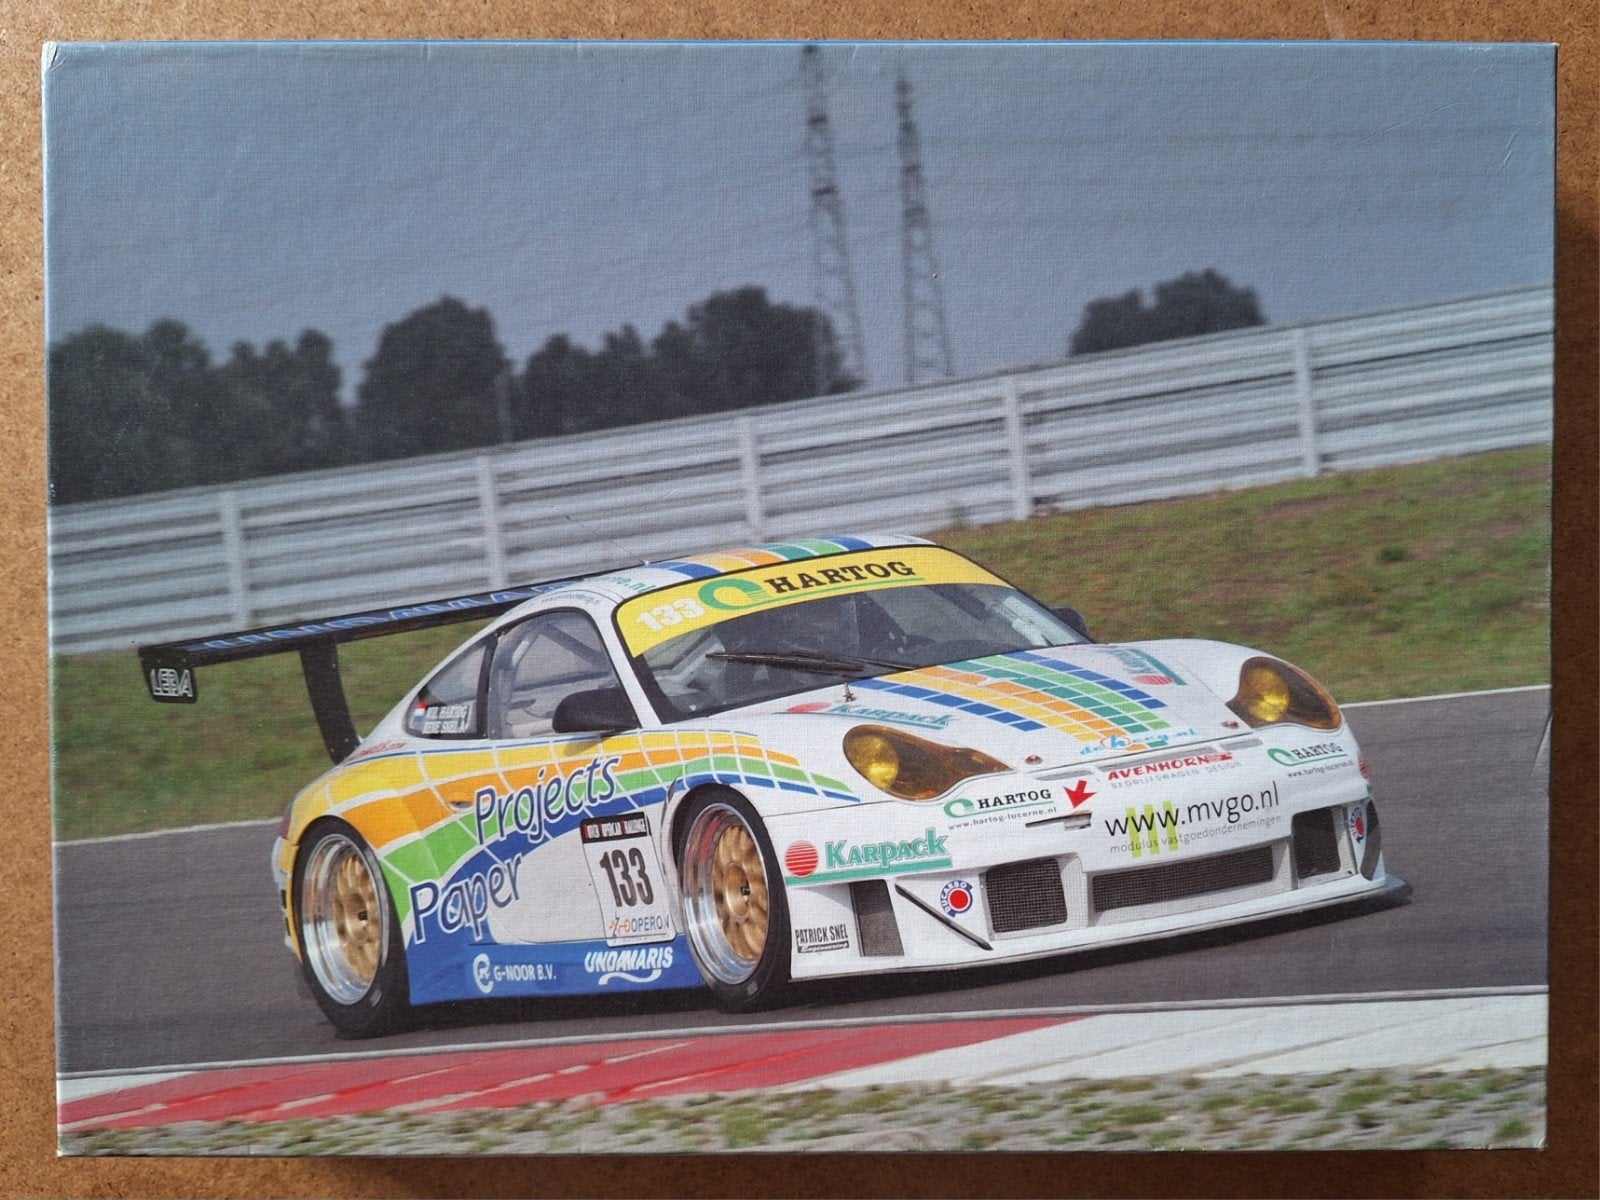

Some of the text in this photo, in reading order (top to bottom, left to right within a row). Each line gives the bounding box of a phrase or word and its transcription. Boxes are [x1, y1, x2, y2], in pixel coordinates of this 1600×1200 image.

[765, 561, 917, 593] HARTOG
[636, 598, 706, 631] 133
[1291, 742, 1343, 760] HARTOG
[1108, 755, 1210, 781] AVENHORN
[476, 755, 622, 845] Projects
[978, 789, 1052, 809] HARTOG
[1105, 780, 1279, 836] www.mvgo.nl
[948, 806, 1057, 830] www.hartog-lucerne.nl
[1110, 815, 1282, 854] modulus vastgoedondernemingen
[600, 847, 654, 908] 133
[409, 853, 522, 944] Paper
[795, 924, 848, 944] PATRICK SNEL
[494, 964, 557, 981] G-NOOR B.V.
[584, 946, 674, 973] UNDAMARIS
